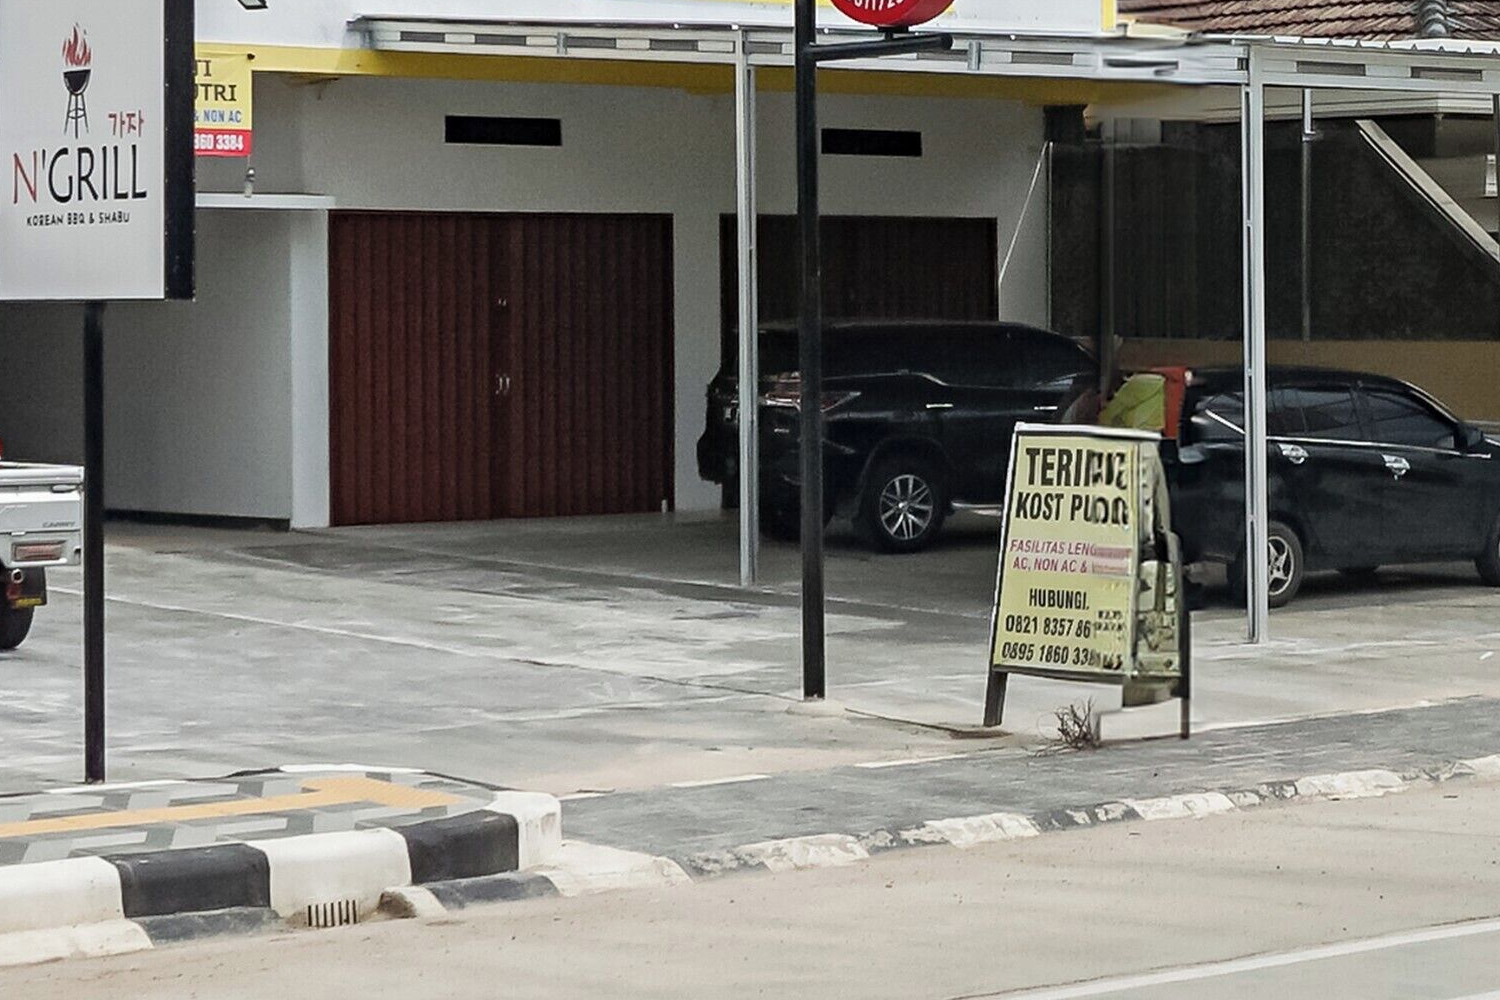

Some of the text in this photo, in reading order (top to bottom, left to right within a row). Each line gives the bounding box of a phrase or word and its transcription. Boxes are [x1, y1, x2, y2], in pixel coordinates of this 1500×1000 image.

[108, 110, 144, 138] 가자
[203, 109, 225, 123] NON
[228, 110, 242, 123] AC
[13, 144, 147, 204] N'GRILL
[27, 214, 63, 226] KOREAN
[67, 212, 85, 225] BBQ
[99, 210, 130, 224] SHABU
[1015, 491, 1064, 520] KOST
[1010, 540, 1065, 556] FASILITAS
[1013, 557, 1031, 571] AC,
[1034, 558, 1057, 571] NON
[1061, 560, 1076, 573] AC
[1080, 561, 1088, 573] &
[1005, 614, 1038, 635] 0821
[1043, 618, 1074, 637] 8357
[1002, 641, 1035, 663] 0895
[1039, 644, 1069, 665] 1860
